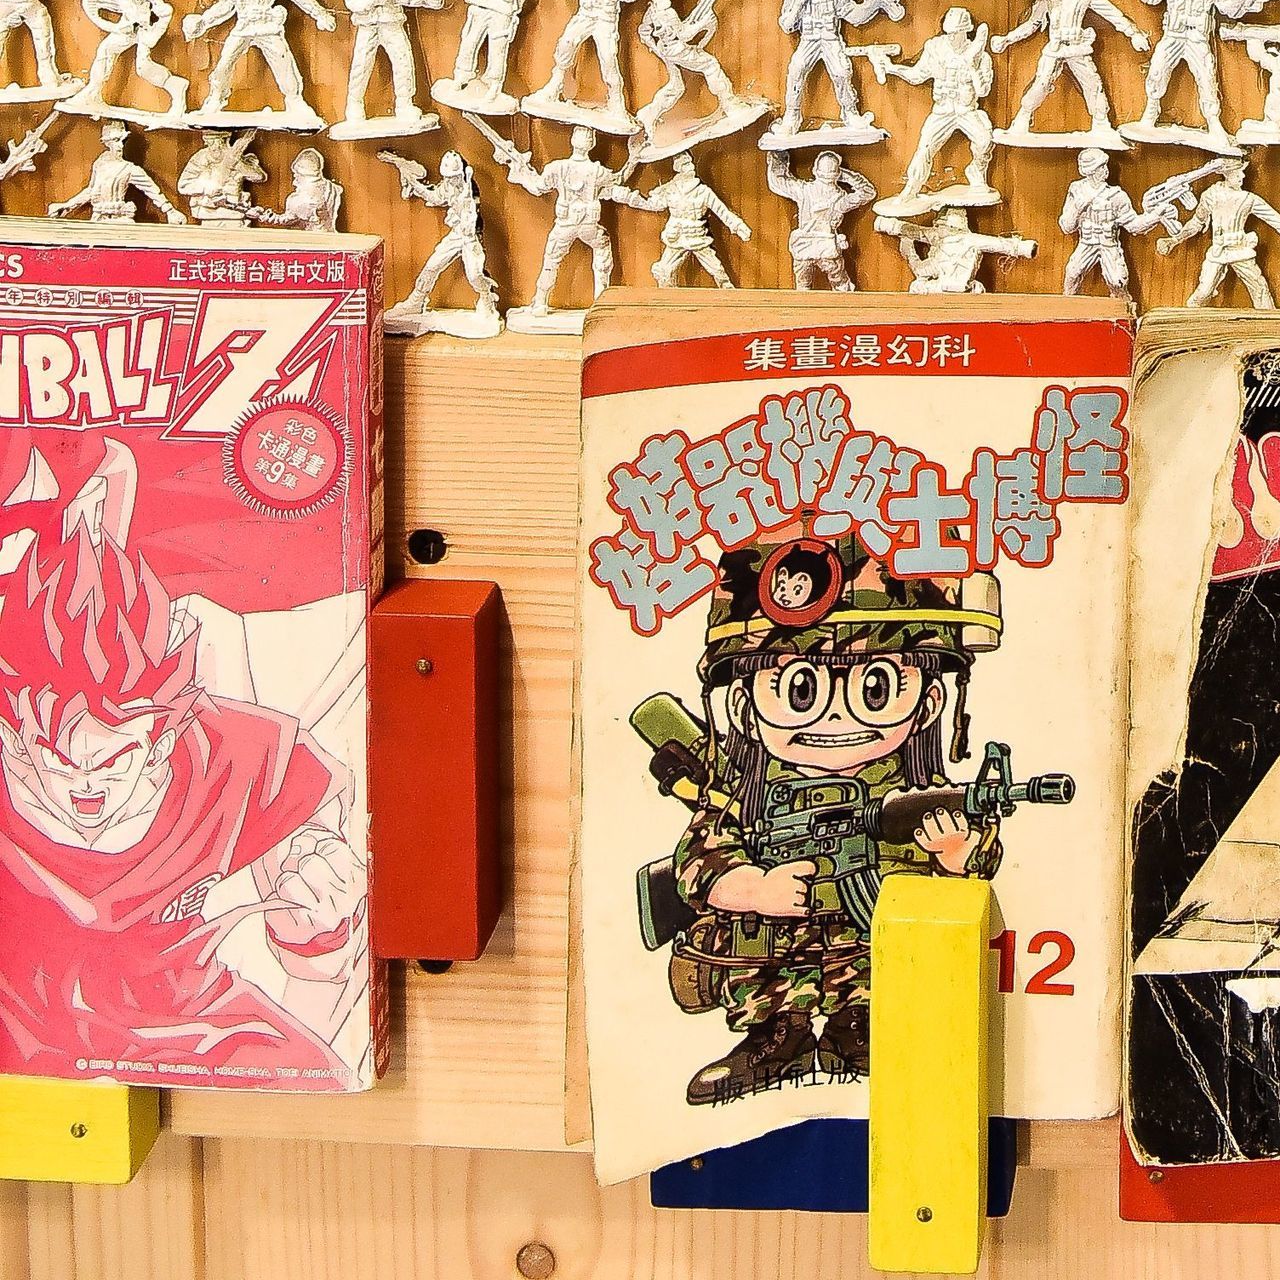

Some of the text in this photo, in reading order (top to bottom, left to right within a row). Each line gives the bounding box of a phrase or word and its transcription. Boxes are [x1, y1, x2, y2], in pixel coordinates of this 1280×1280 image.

[169, 258, 346, 284] 正式授權台灣中文版
[284, 418, 318, 445] 彩色
[258, 429, 326, 479] 卡通漫畫
[255, 457, 300, 490] 第9集
[988, 930, 1076, 997] 12
